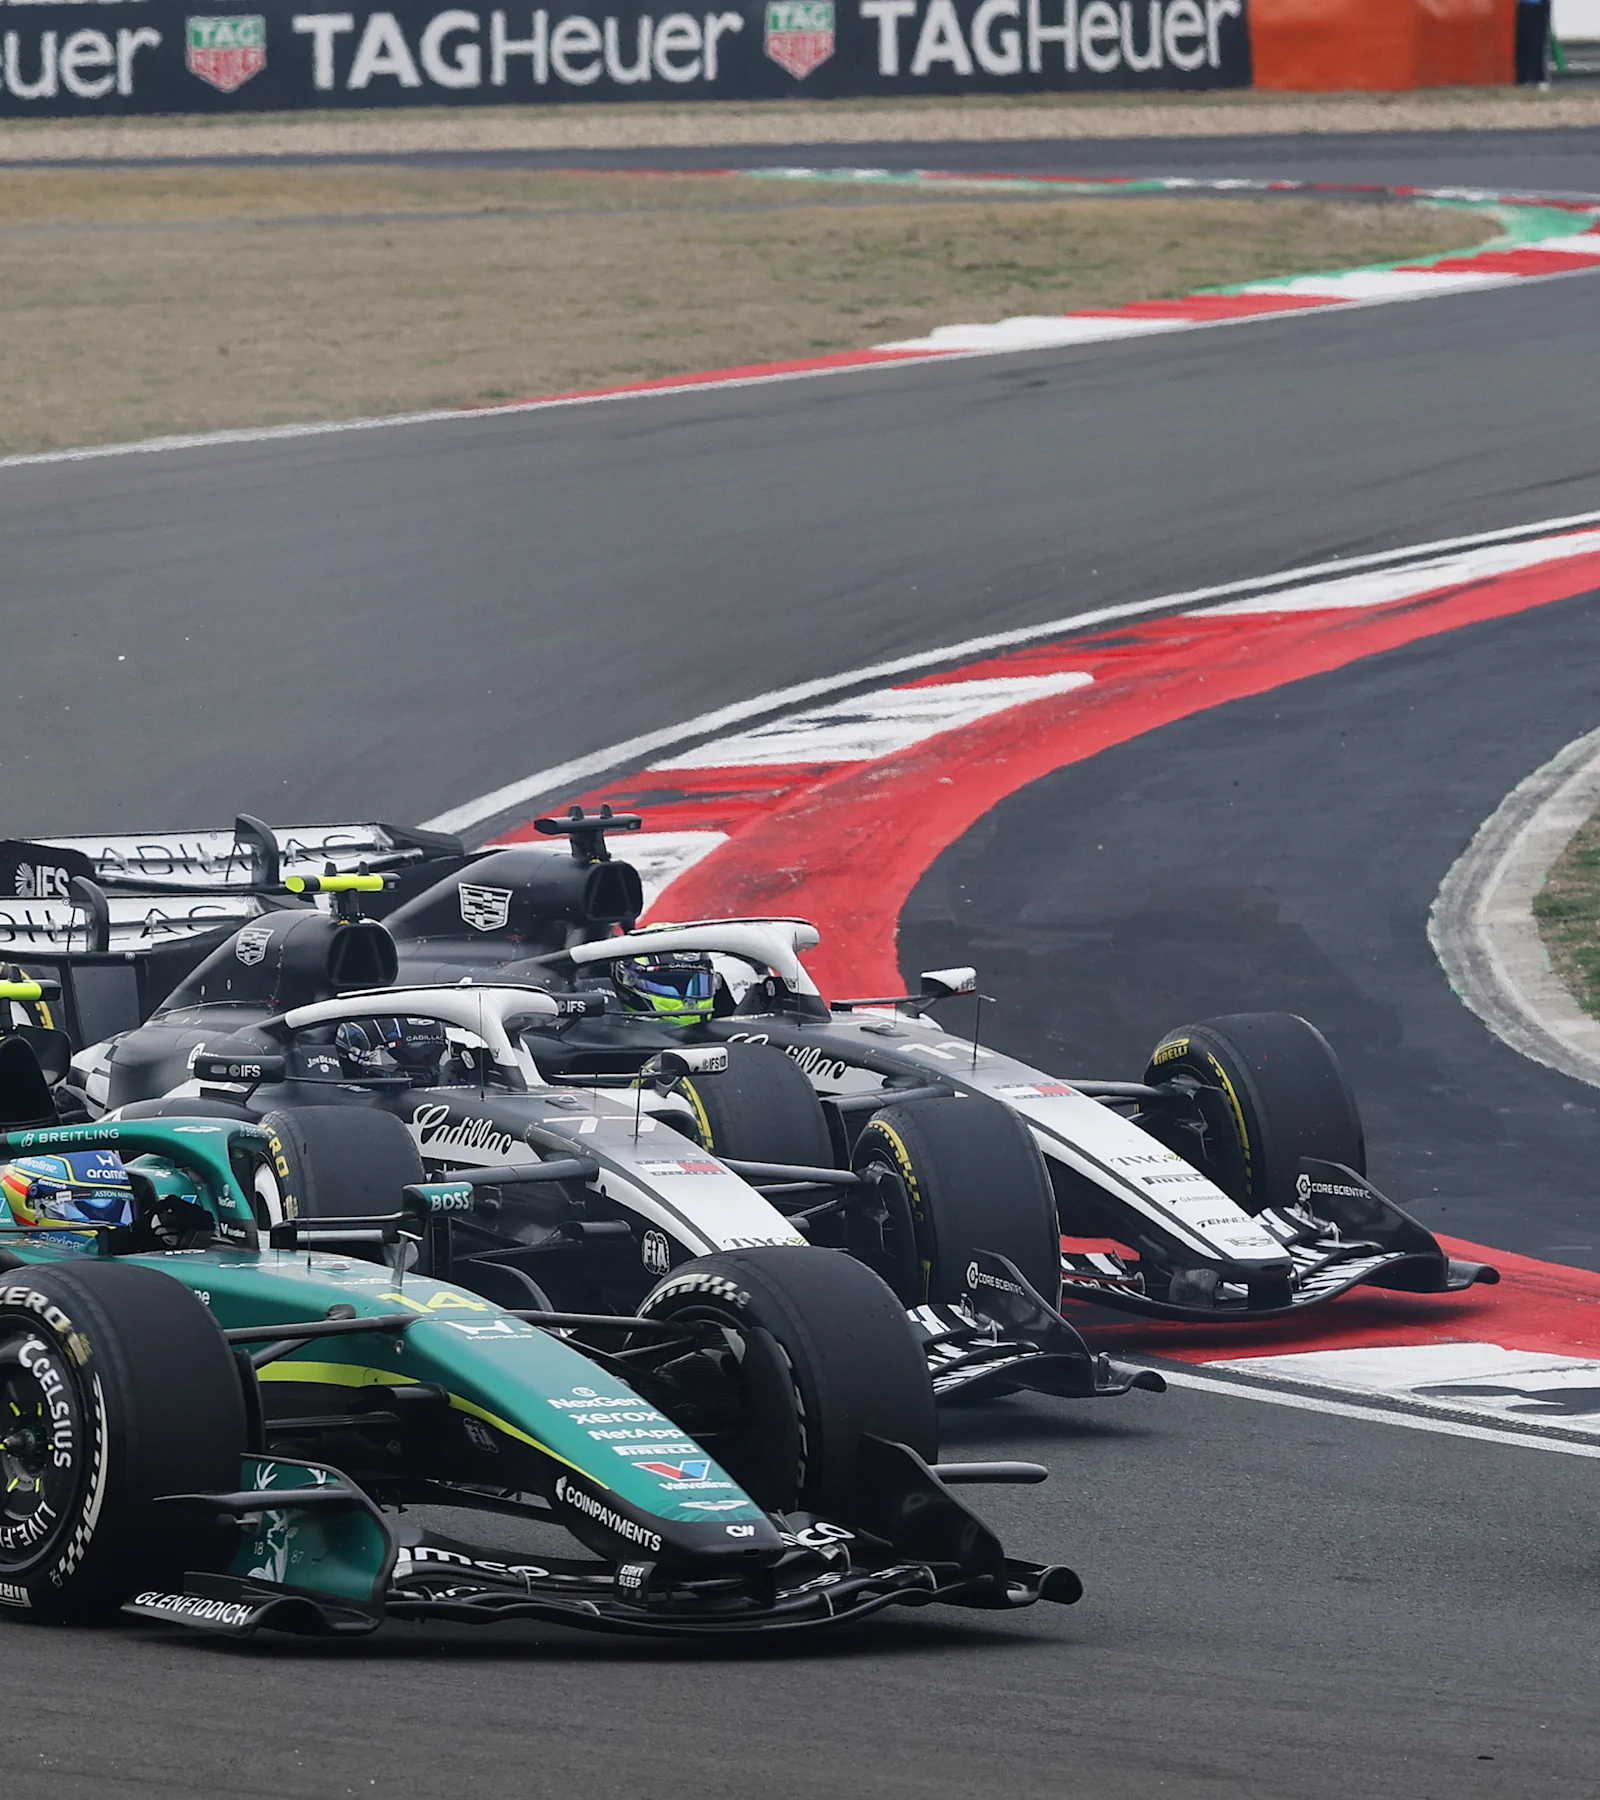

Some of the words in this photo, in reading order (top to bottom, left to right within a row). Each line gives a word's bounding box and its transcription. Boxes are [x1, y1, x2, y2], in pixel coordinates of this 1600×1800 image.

[567, 1001, 586, 1013] IFS
[1153, 1038, 1190, 1066] PIRELLI
[240, 1065, 261, 1078] IFS
[38, 1128, 119, 1144] BREITLING
[413, 1103, 512, 1155] Cadillac
[430, 1191, 469, 1212] BOSS
[377, 1291, 488, 1313] 14
[547, 1396, 648, 1410] NexGen
[568, 1410, 668, 1425] xerox
[587, 1428, 685, 1441] NetApp
[612, 1443, 699, 1456] PIRELLI
[659, 1480, 733, 1490] Valvoline
[566, 1486, 663, 1552] COINPAYMENTS
[253, 1541, 264, 1556] 18
[291, 1550, 304, 1564] 87
[398, 1546, 550, 1578] mco
[620, 1563, 644, 1578] EIGHT
[618, 1574, 642, 1589] SLEEP
[134, 1591, 253, 1626] GLENFIDDICH
